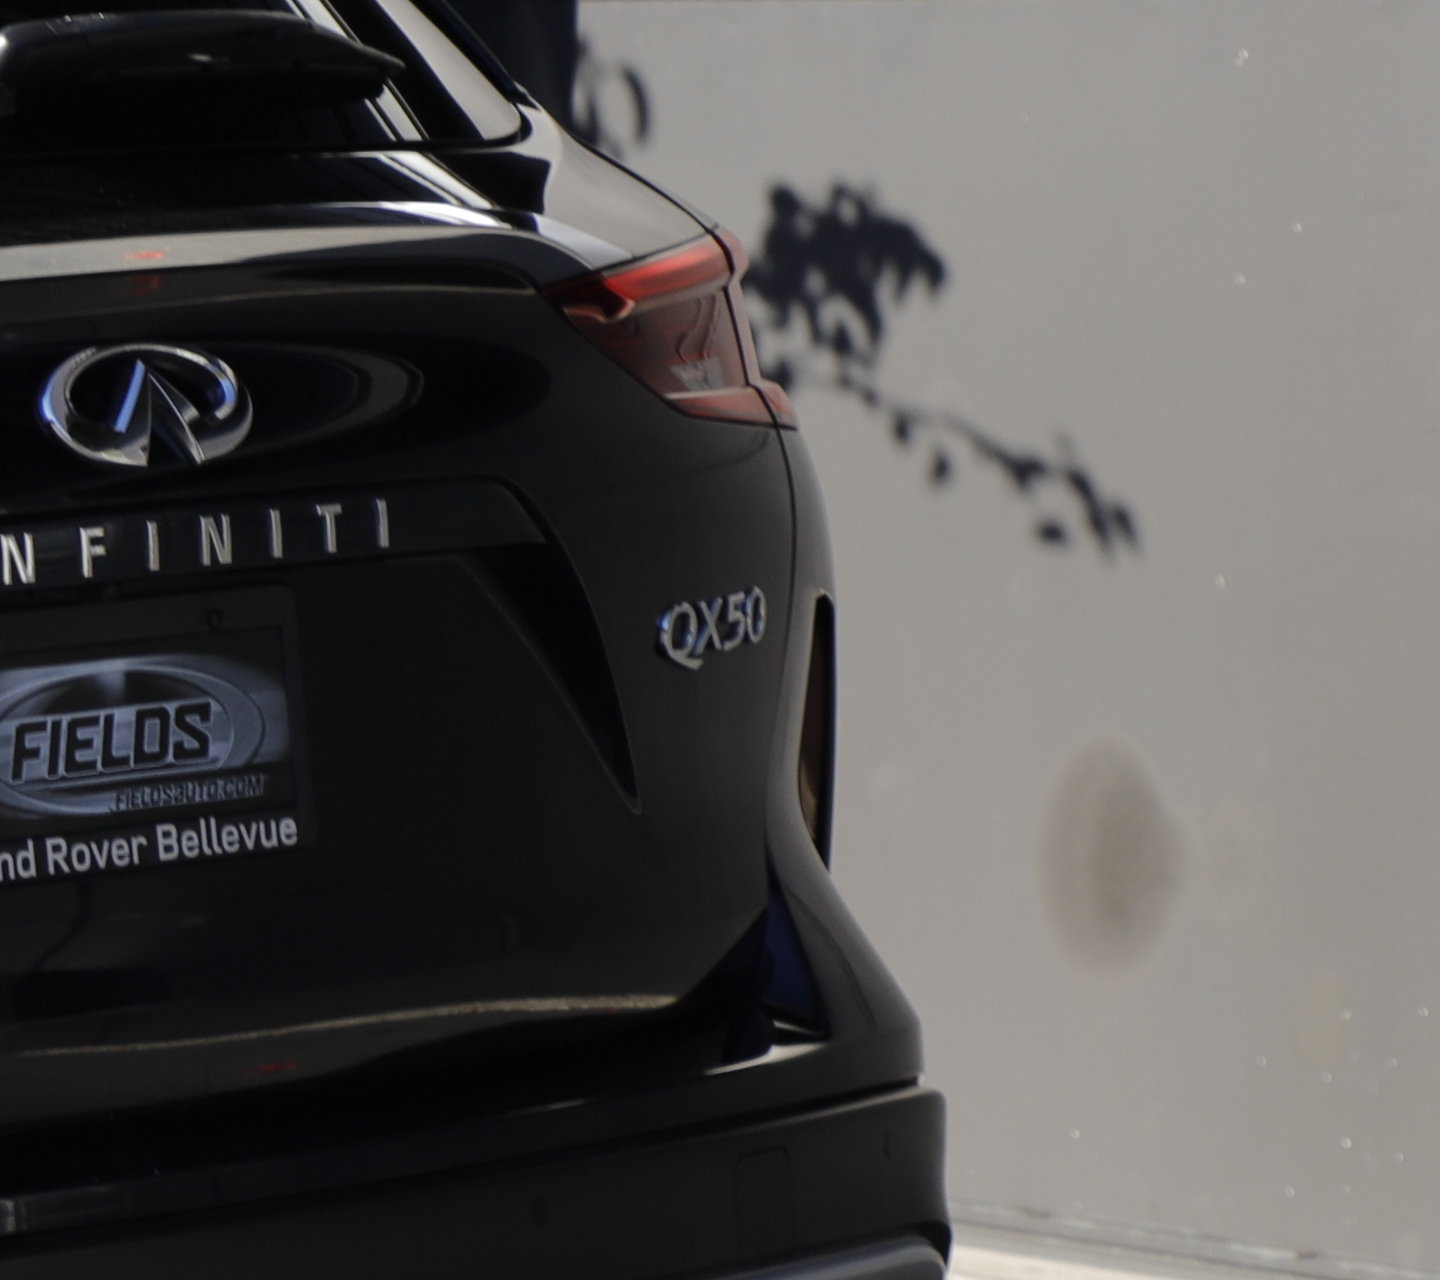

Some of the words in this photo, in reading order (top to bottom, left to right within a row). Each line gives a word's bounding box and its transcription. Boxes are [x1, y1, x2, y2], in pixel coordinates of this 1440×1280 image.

[658, 585, 767, 670] QX50
[11, 698, 214, 785] FIELDS
[45, 833, 148, 875] Rover
[155, 816, 299, 862] Bellevue
